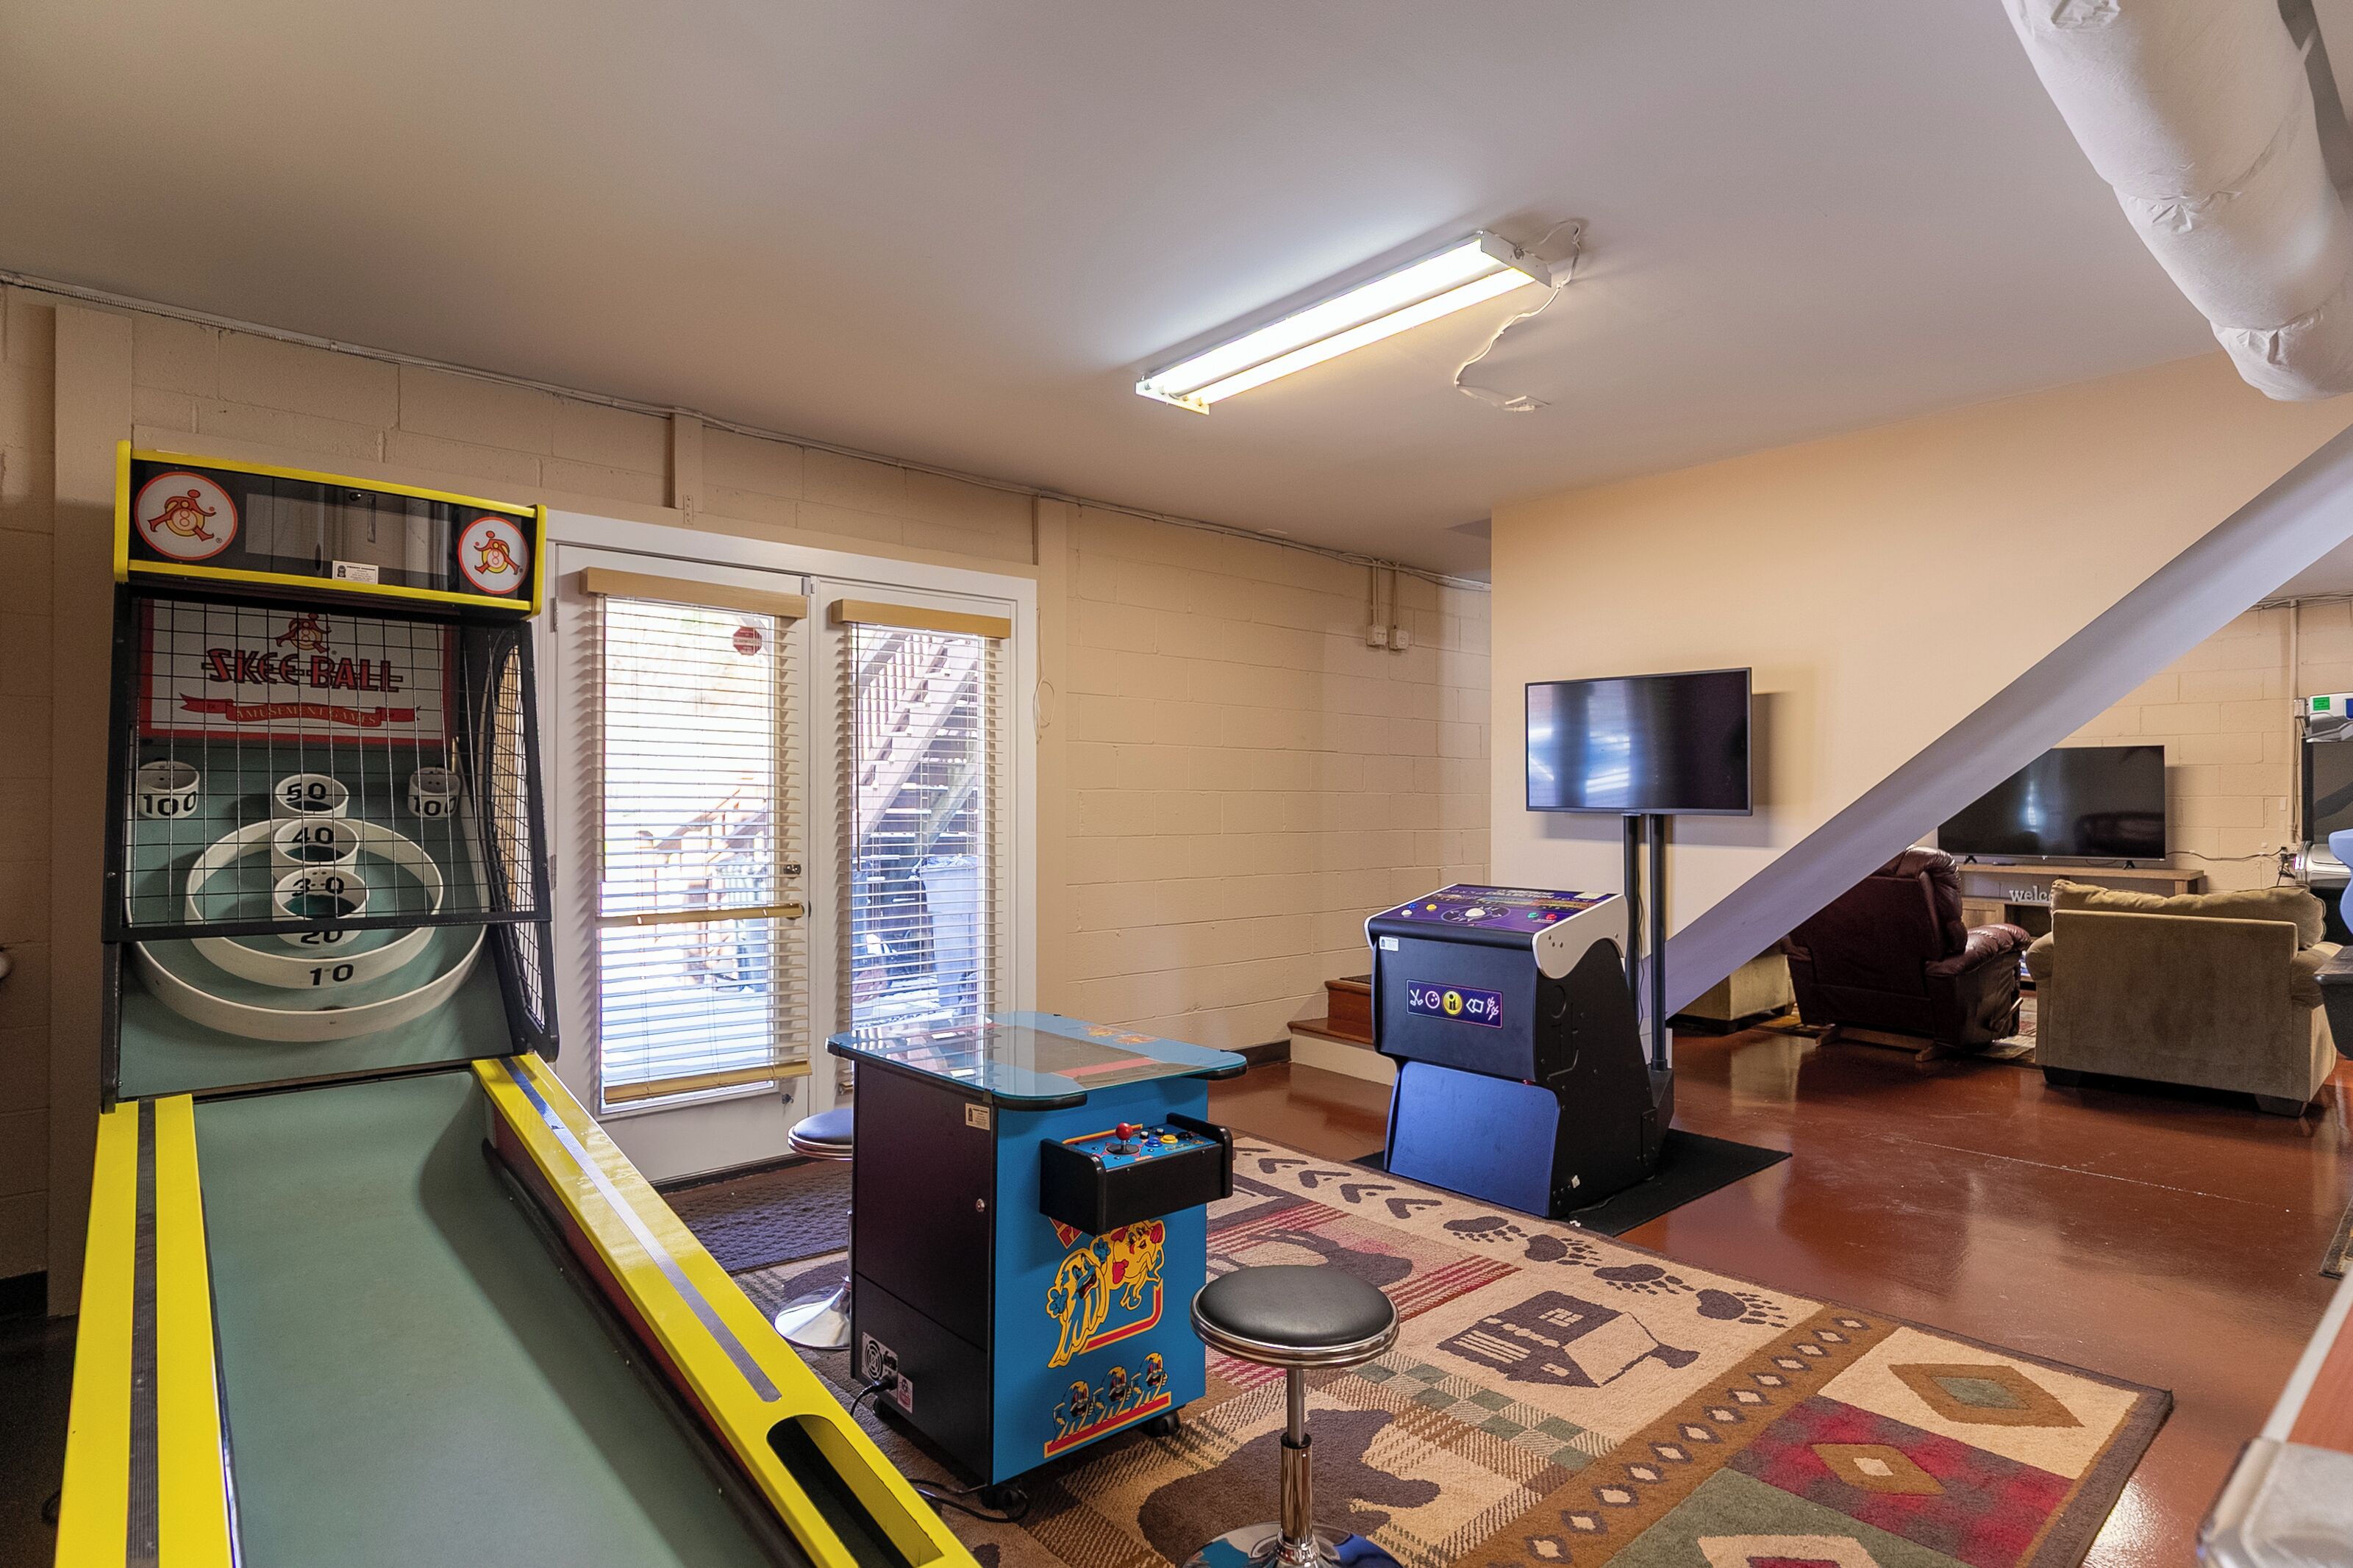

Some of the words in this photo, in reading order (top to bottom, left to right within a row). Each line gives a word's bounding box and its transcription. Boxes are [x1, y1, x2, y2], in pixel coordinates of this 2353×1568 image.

[206, 648, 300, 684] SKEE
[310, 654, 399, 692] BALL
[238, 704, 325, 719] AMUSEMENT
[286, 782, 326, 801] 50
[143, 791, 197, 816] 100
[414, 796, 457, 816] 100
[291, 827, 334, 845] 40
[292, 876, 344, 897] 30
[300, 930, 343, 945] 20
[310, 964, 354, 986] 10
